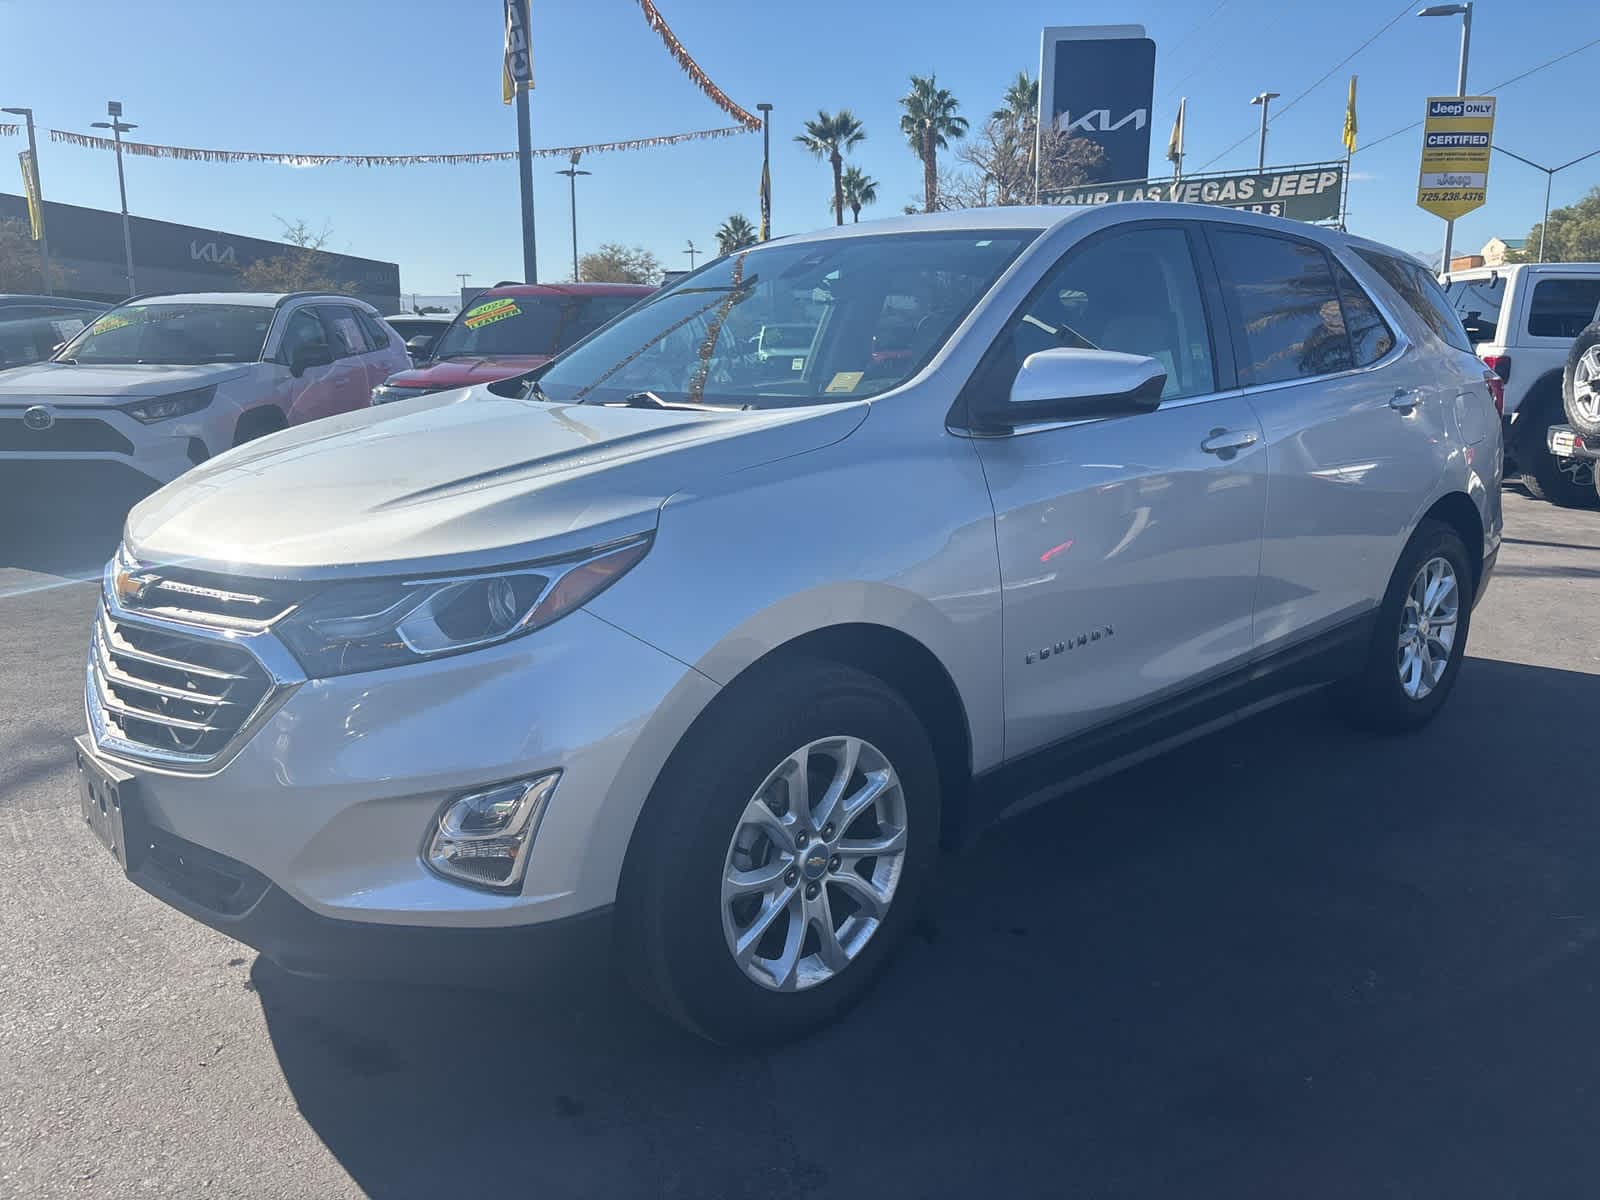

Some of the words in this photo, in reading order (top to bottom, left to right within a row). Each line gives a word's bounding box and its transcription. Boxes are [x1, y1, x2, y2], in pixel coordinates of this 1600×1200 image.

[1060, 109, 1147, 131] KIA
[1432, 103, 1462, 115] Jeep
[1466, 105, 1491, 113] ONLY
[1428, 135, 1487, 145] CERTIFIED
[1168, 177, 1256, 203] VEGAS
[1263, 171, 1338, 199] JEEP
[191, 240, 235, 263] KIA
